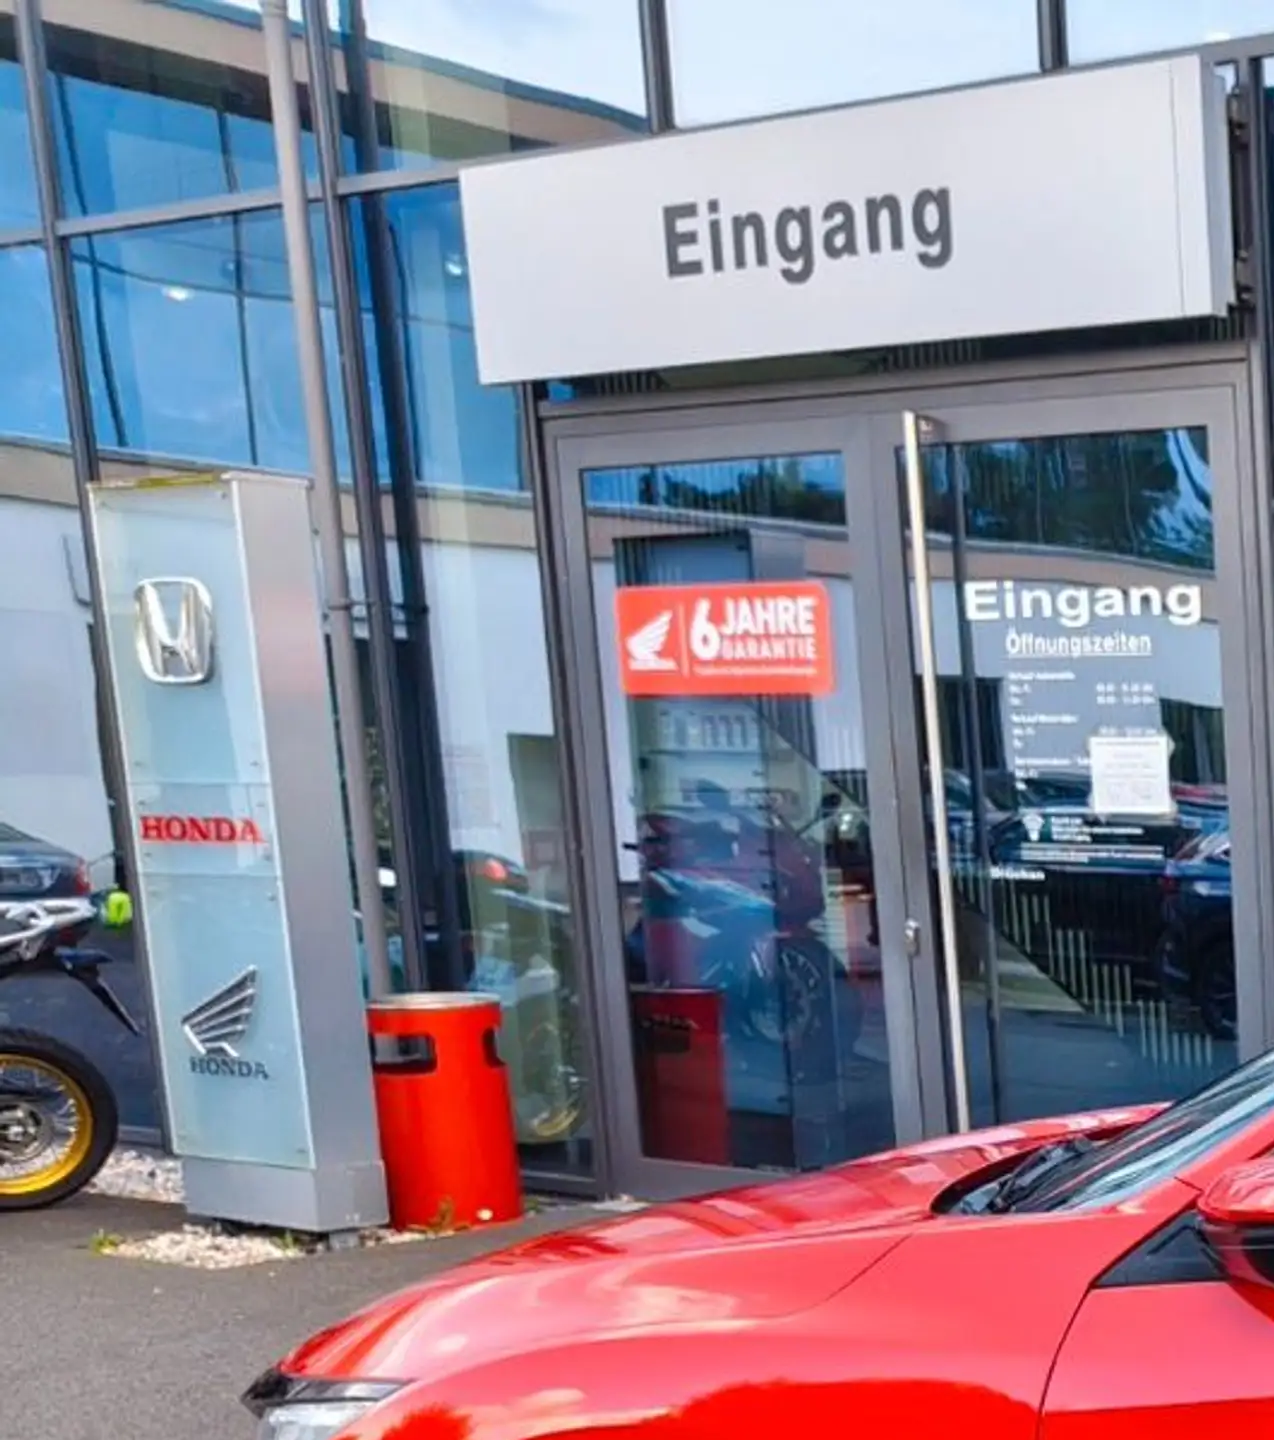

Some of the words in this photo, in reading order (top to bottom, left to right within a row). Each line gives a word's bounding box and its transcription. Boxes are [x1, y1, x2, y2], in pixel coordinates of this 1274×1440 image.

[662, 186, 953, 285] Eingang
[964, 580, 1201, 627] Eingang
[689, 597, 721, 661] 6
[718, 596, 818, 637] JAHRE
[1005, 626, 1152, 658] Öffnungszeiten
[722, 637, 818, 661] GARANTIE
[139, 814, 269, 845] HONDA
[189, 1055, 270, 1081] HONDA
